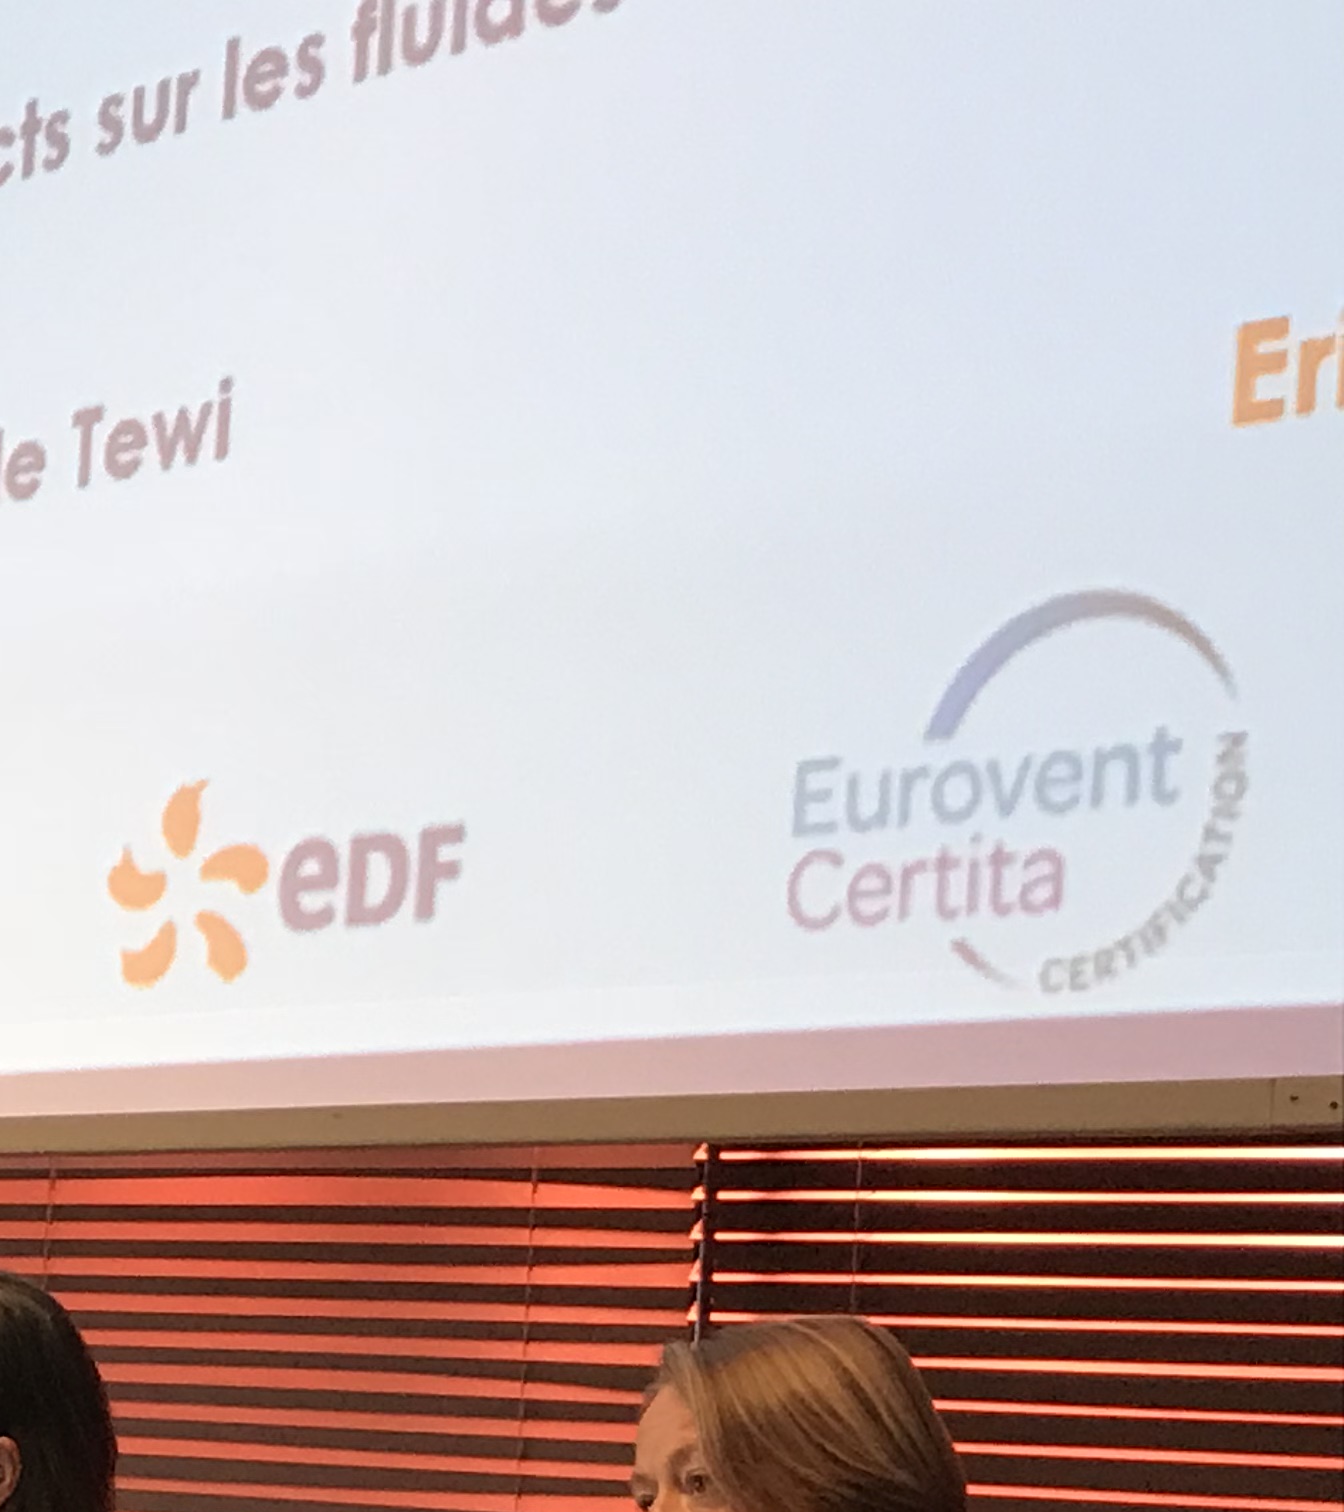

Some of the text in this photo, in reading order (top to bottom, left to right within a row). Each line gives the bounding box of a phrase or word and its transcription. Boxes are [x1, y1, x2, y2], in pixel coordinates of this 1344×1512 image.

[94, 68, 202, 156] sur
[221, 31, 326, 121] les
[72, 376, 235, 490] Tewi
[791, 725, 1184, 839] Eurovent
[785, 833, 1066, 932] Certita
[1038, 730, 1249, 995] CERTIFICATION
